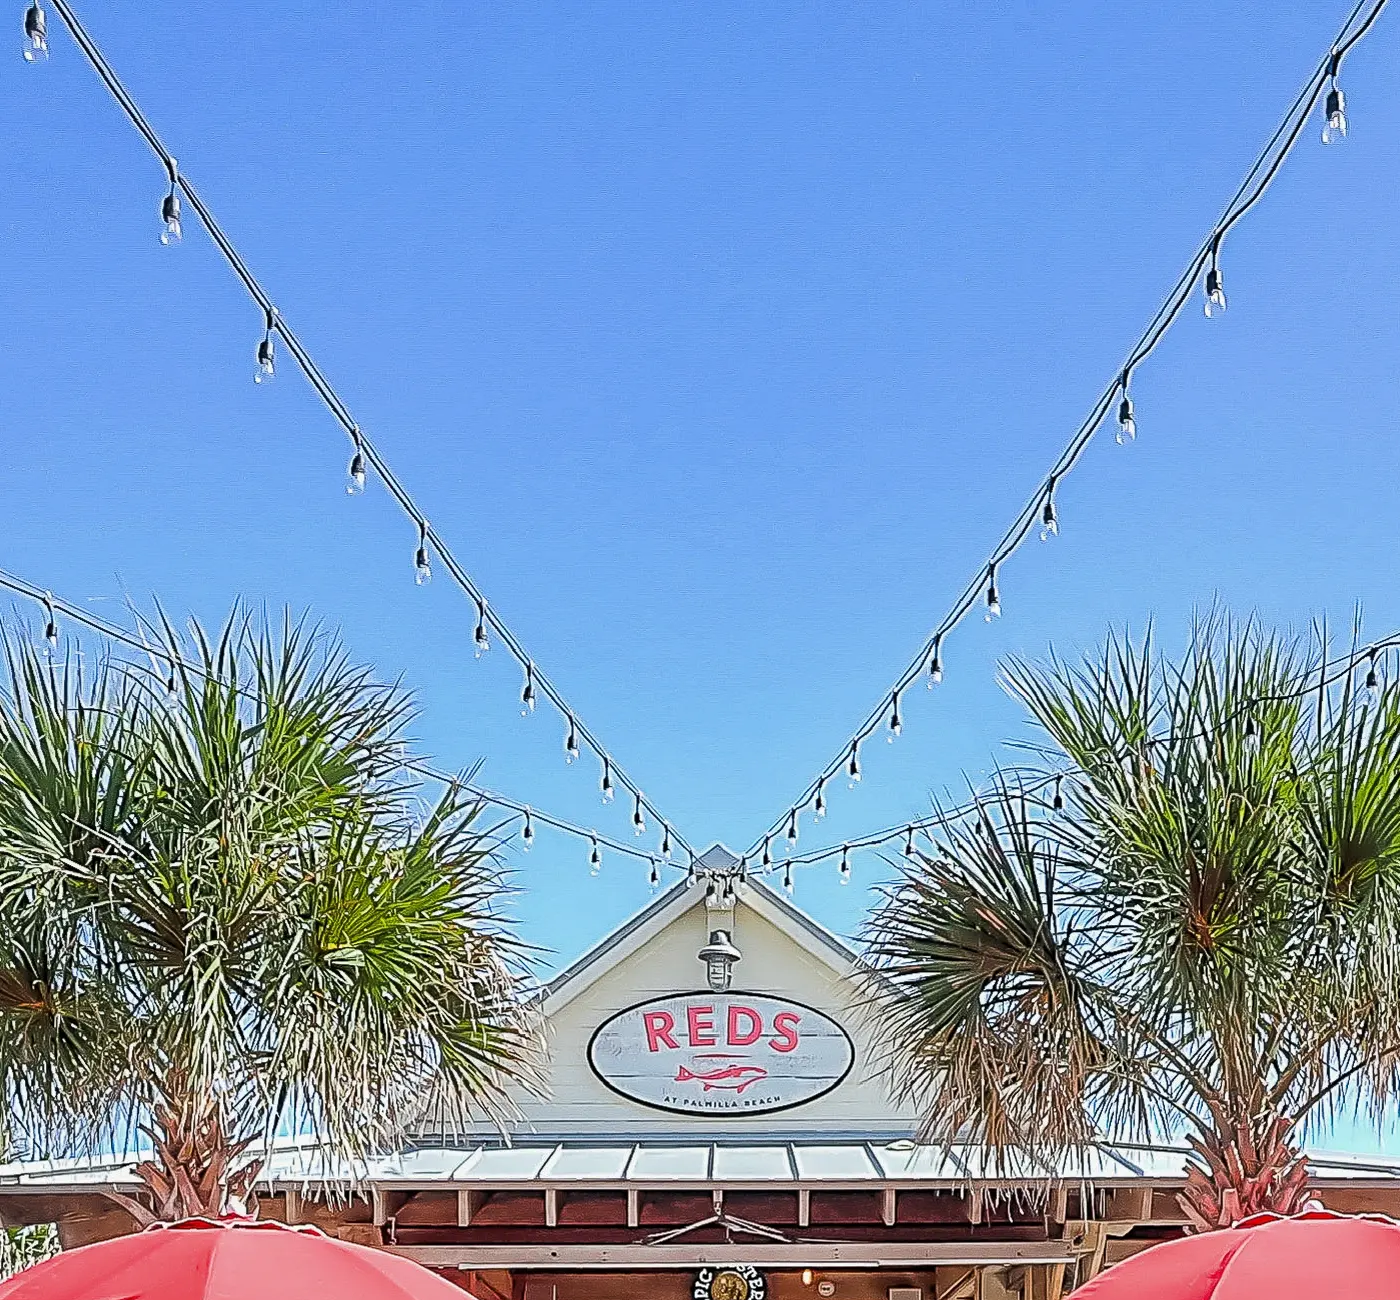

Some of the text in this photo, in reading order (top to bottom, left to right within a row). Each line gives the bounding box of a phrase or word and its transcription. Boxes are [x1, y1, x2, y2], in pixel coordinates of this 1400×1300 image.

[643, 1004, 801, 1052] REDS
[663, 1096, 781, 1108] AT PALMILLA BEACH
